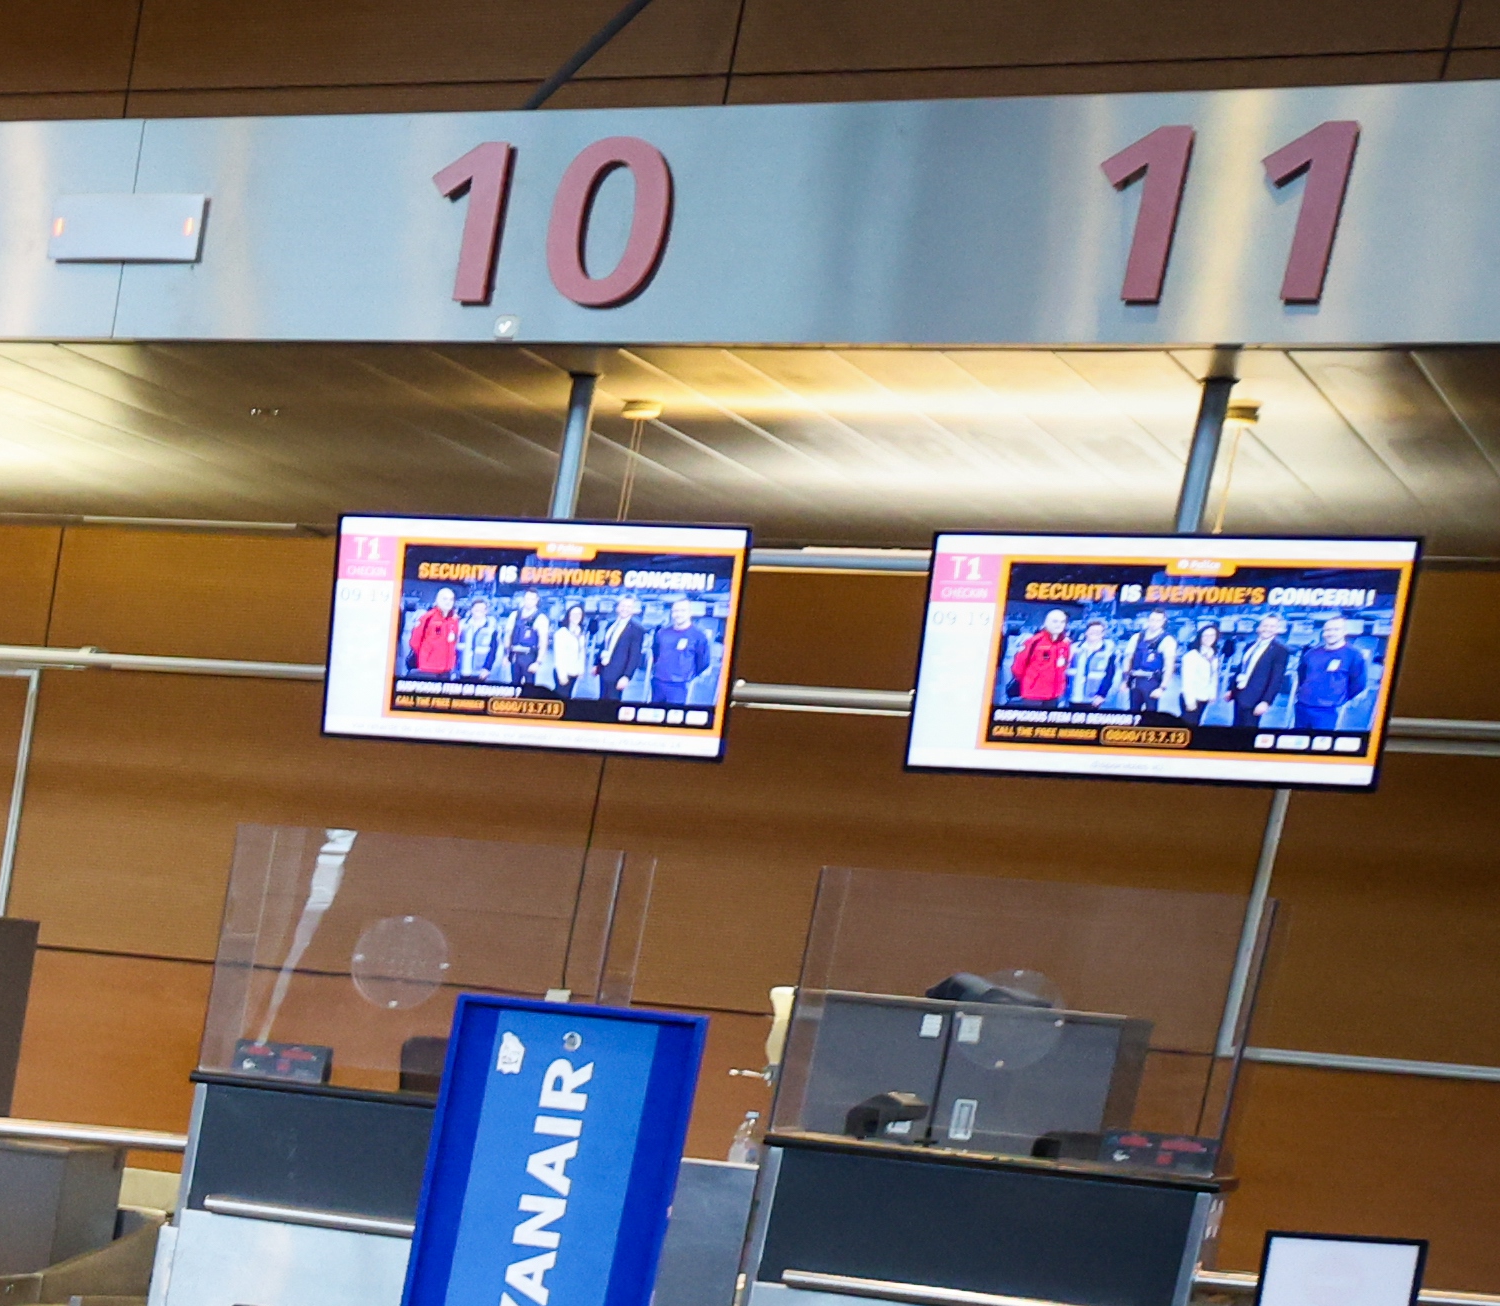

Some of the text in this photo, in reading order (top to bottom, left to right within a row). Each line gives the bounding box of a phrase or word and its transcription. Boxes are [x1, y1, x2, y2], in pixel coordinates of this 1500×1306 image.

[432, 135, 674, 307] 10
[1100, 120, 1361, 303] 11
[353, 537, 380, 560] T1
[419, 562, 496, 581] SECURITY
[500, 564, 517, 582] IS
[520, 567, 621, 586] EVERYONE'S
[951, 556, 980, 581] T1
[941, 587, 988, 600] CHECKIN
[1025, 582, 1116, 602] SECURITY
[1121, 584, 1141, 602] IS
[1146, 585, 1264, 604] EVERYONE'S
